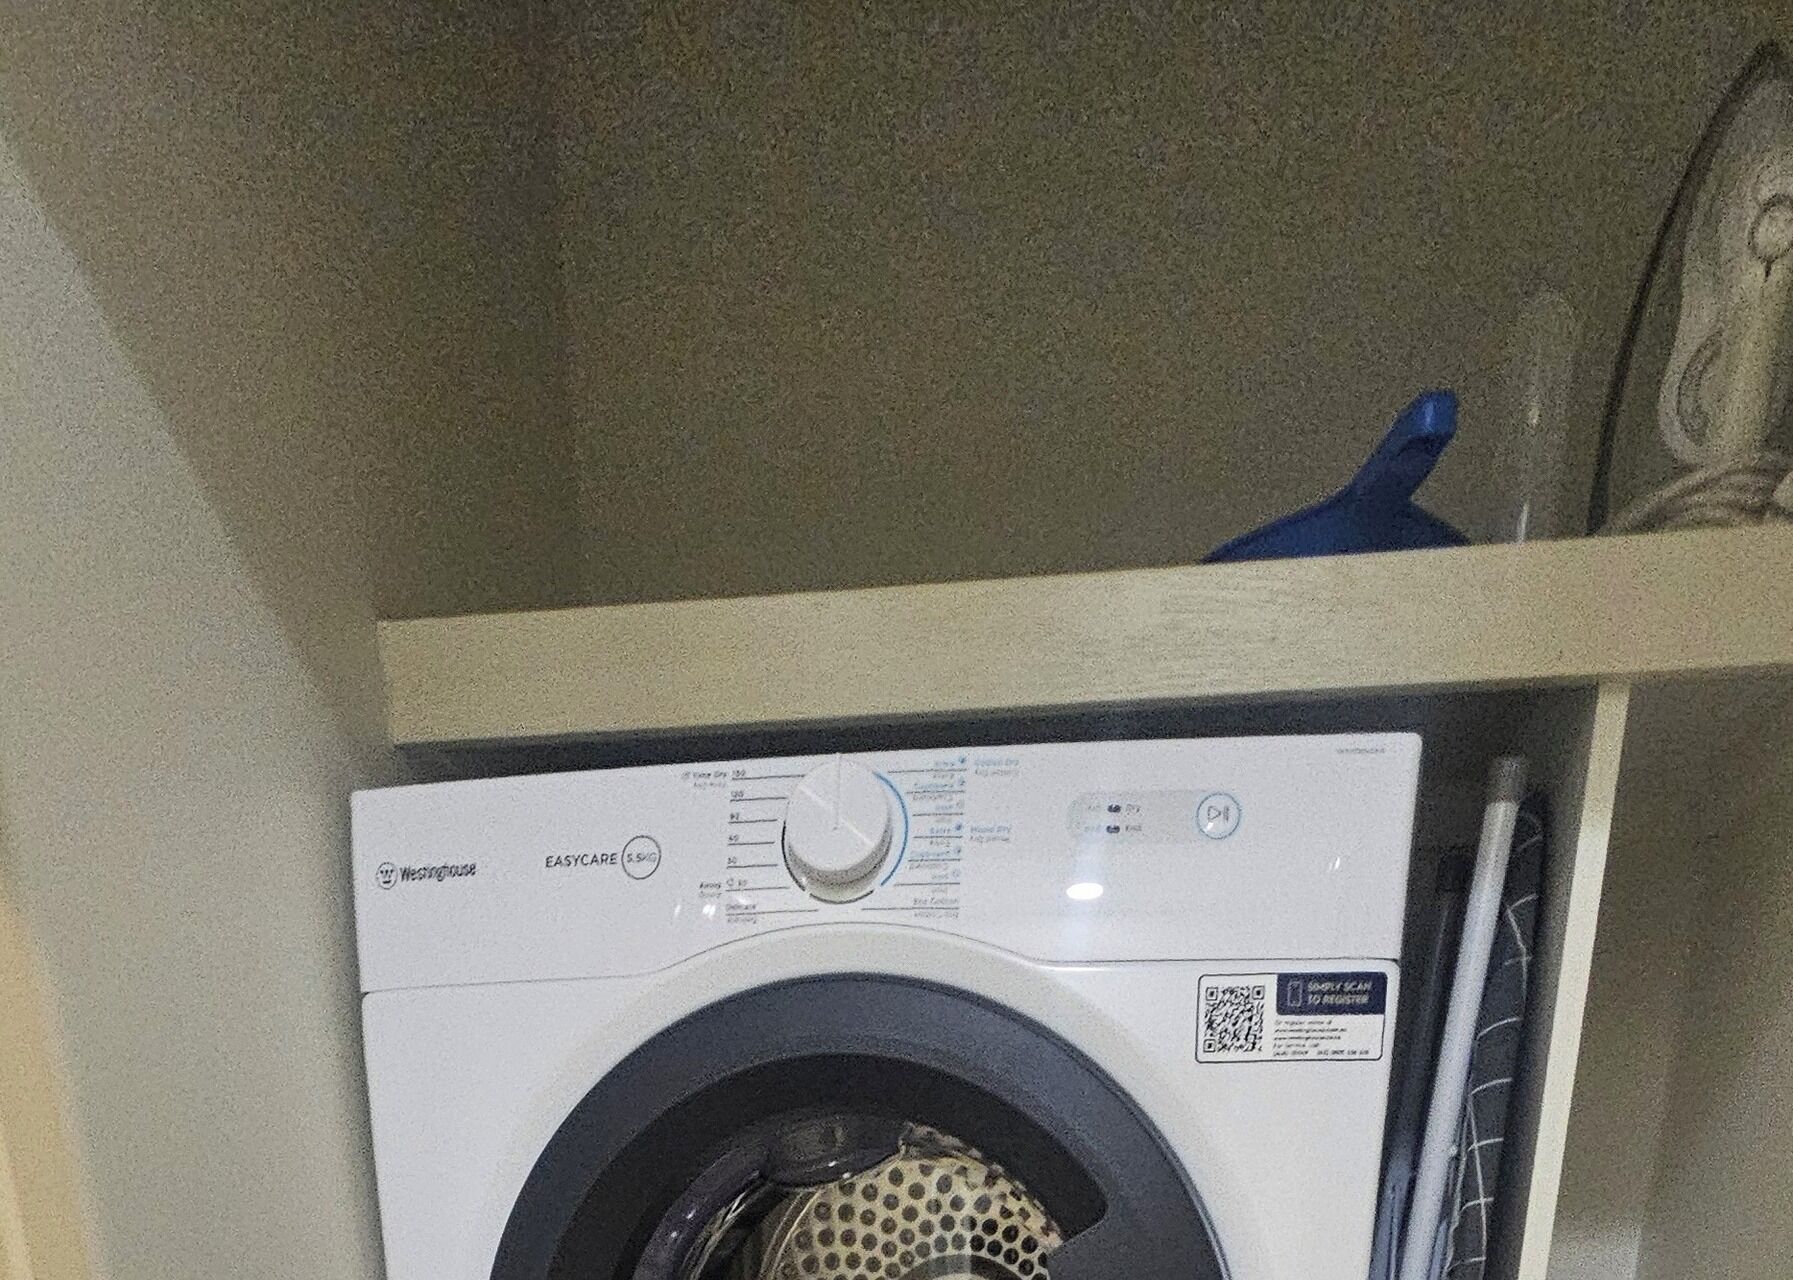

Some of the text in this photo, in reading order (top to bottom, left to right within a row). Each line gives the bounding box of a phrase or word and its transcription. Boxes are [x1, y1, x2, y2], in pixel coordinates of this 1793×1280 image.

[545, 852, 618, 868] EASYCARE
[399, 862, 477, 882] Westinghouse
[1343, 980, 1373, 991] SCAN
[1308, 993, 1369, 1005] TO REGISTER
